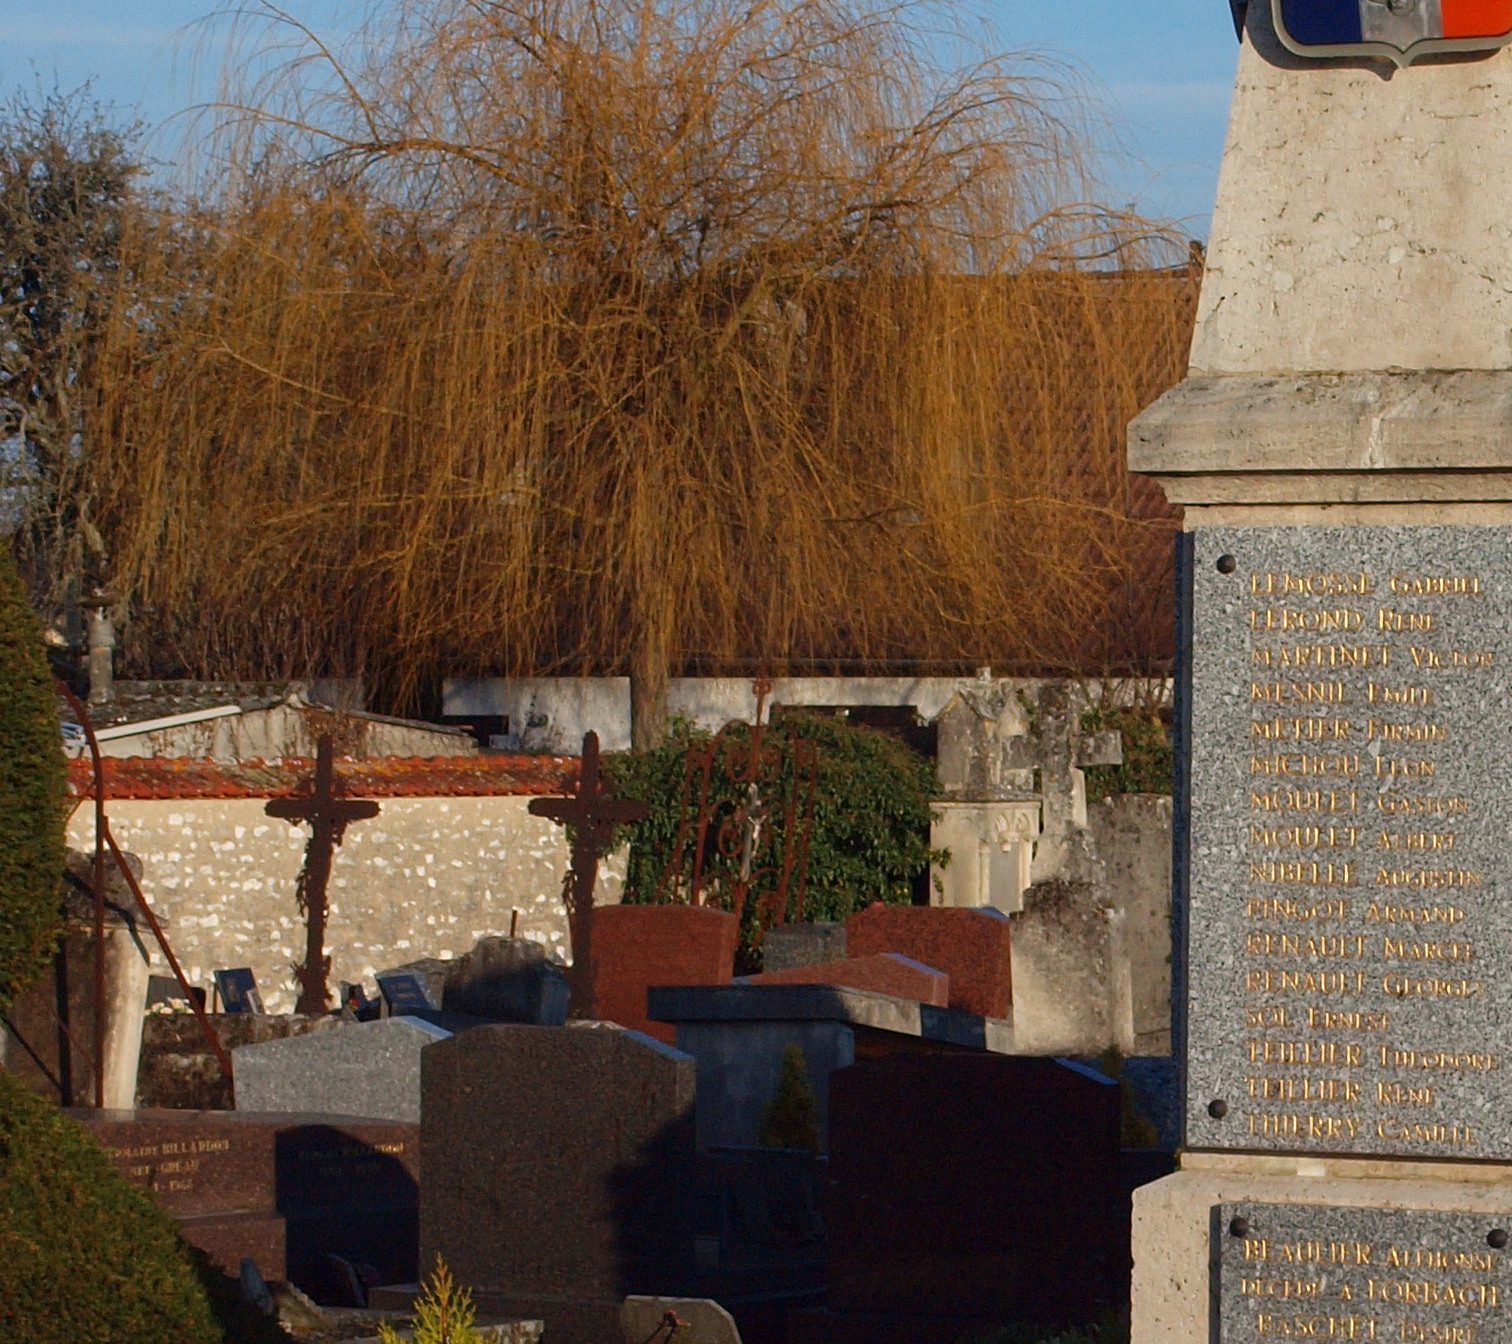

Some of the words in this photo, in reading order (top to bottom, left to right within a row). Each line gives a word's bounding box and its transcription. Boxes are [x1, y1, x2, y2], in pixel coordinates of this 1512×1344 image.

[1391, 573, 1482, 595] GABRIEL
[1250, 609, 1363, 631] LEROND
[1251, 645, 1391, 666] MARTINET
[1410, 646, 1493, 668] VICTOR
[1251, 682, 1352, 703] MESNIL
[1367, 719, 1446, 740] FIRMIN
[1250, 754, 1359, 776] MICHOU
[1250, 790, 1359, 812] MOULET
[1378, 791, 1468, 813] GASTON
[1250, 826, 1363, 848] MOULET
[1376, 829, 1456, 850] ALBERT
[1249, 861, 1358, 885] NIBELLE
[1376, 868, 1481, 887] AUGUSTIN
[1366, 903, 1465, 924] ARMAND
[1247, 934, 1368, 957] RENAULT
[1384, 936, 1472, 961] MARCEL
[1247, 970, 1367, 994] RENAULT
[1383, 973, 1486, 998] GEORGES
[1244, 1006, 1294, 1028] SOL
[1308, 1007, 1390, 1030] ERNEST
[1248, 1114, 1361, 1137] THIERRY
[1377, 1119, 1477, 1143] CAMILLE
[1244, 1239, 1371, 1265] BEAULIER
[1385, 1245, 1498, 1272] ALPHONSE
[1368, 1279, 1498, 1307] FORBACH
[1258, 1313, 1378, 1340] BASCHET
